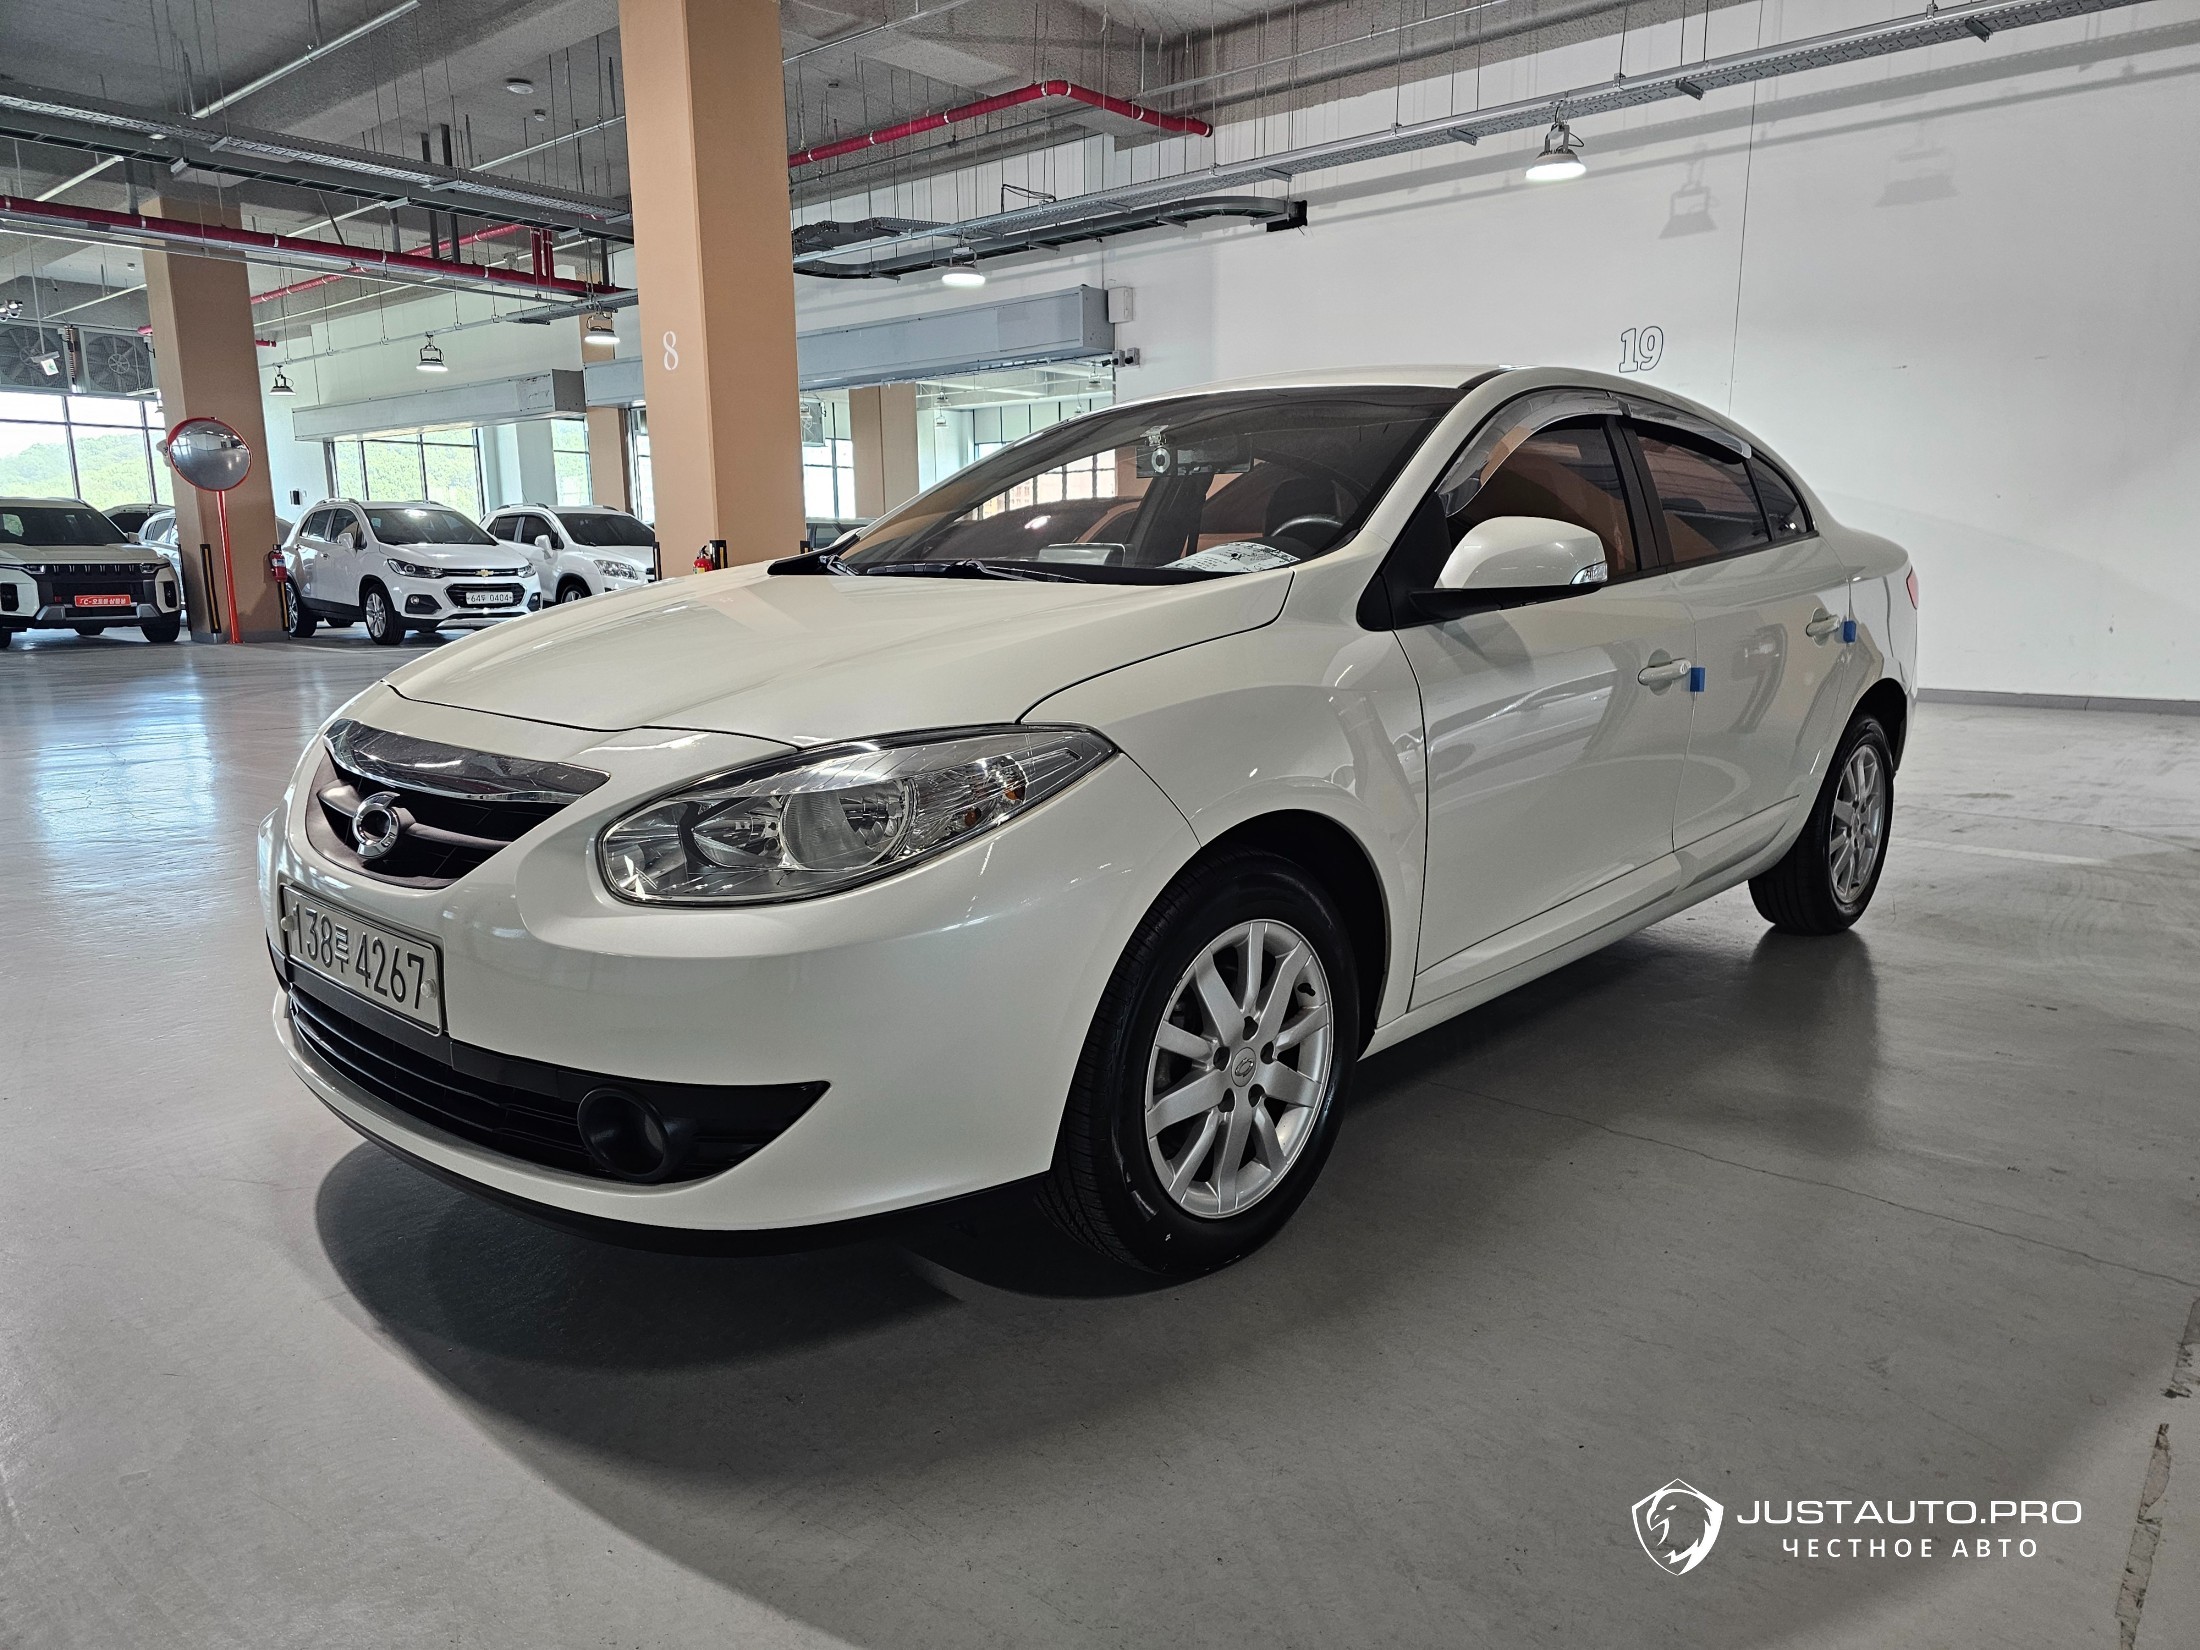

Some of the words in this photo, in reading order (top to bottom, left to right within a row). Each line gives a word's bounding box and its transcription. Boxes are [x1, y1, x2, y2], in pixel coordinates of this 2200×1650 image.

[662, 330, 679, 371] 8
[1618, 325, 1664, 373] 19
[489, 593, 509, 602] 0404
[355, 931, 425, 1010] 4267
